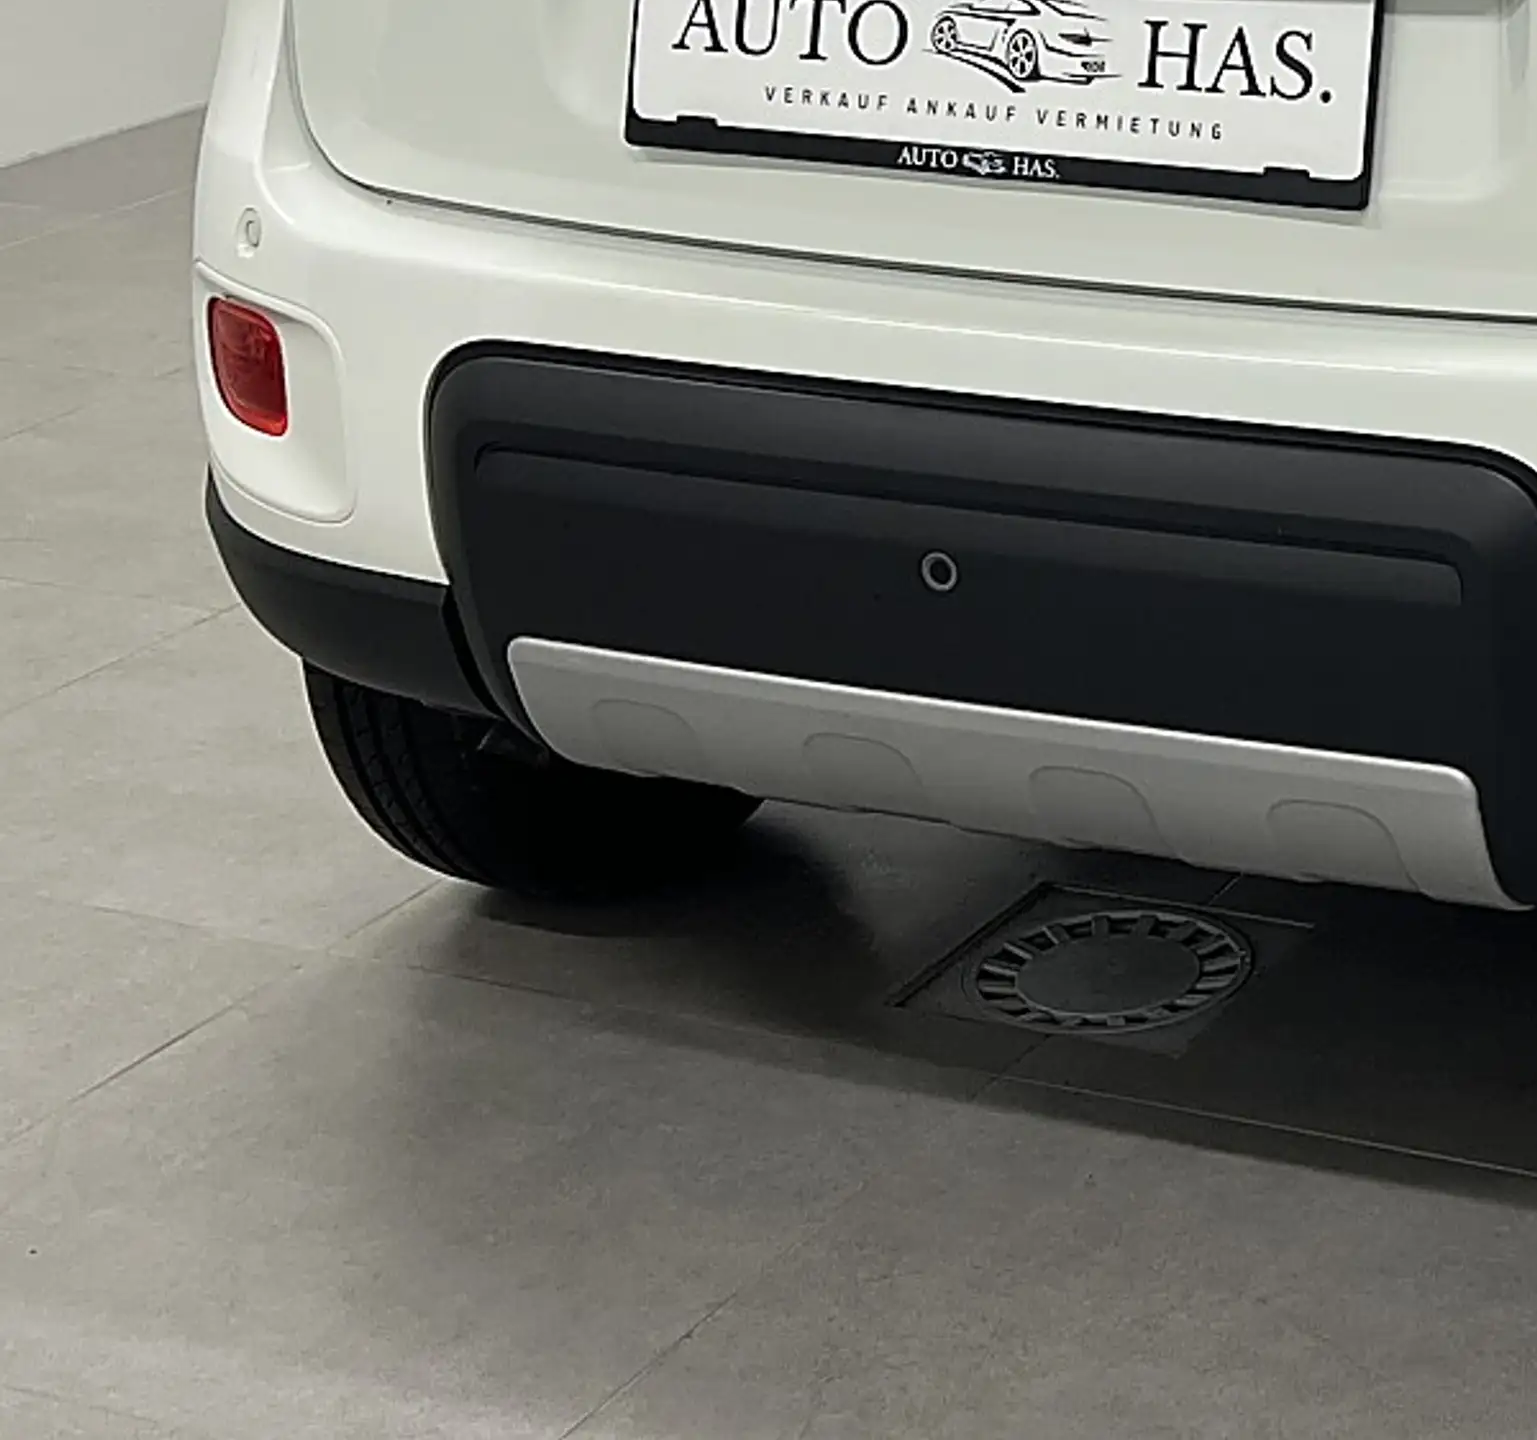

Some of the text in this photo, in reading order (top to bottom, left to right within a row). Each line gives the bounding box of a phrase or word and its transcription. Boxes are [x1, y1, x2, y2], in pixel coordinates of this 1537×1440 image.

[1138, 20, 1332, 103] HAS.
[765, 86, 1223, 140] VERKAUF ANKAUF VERMIETUNG
[898, 146, 1060, 178] AUTO HAS.
